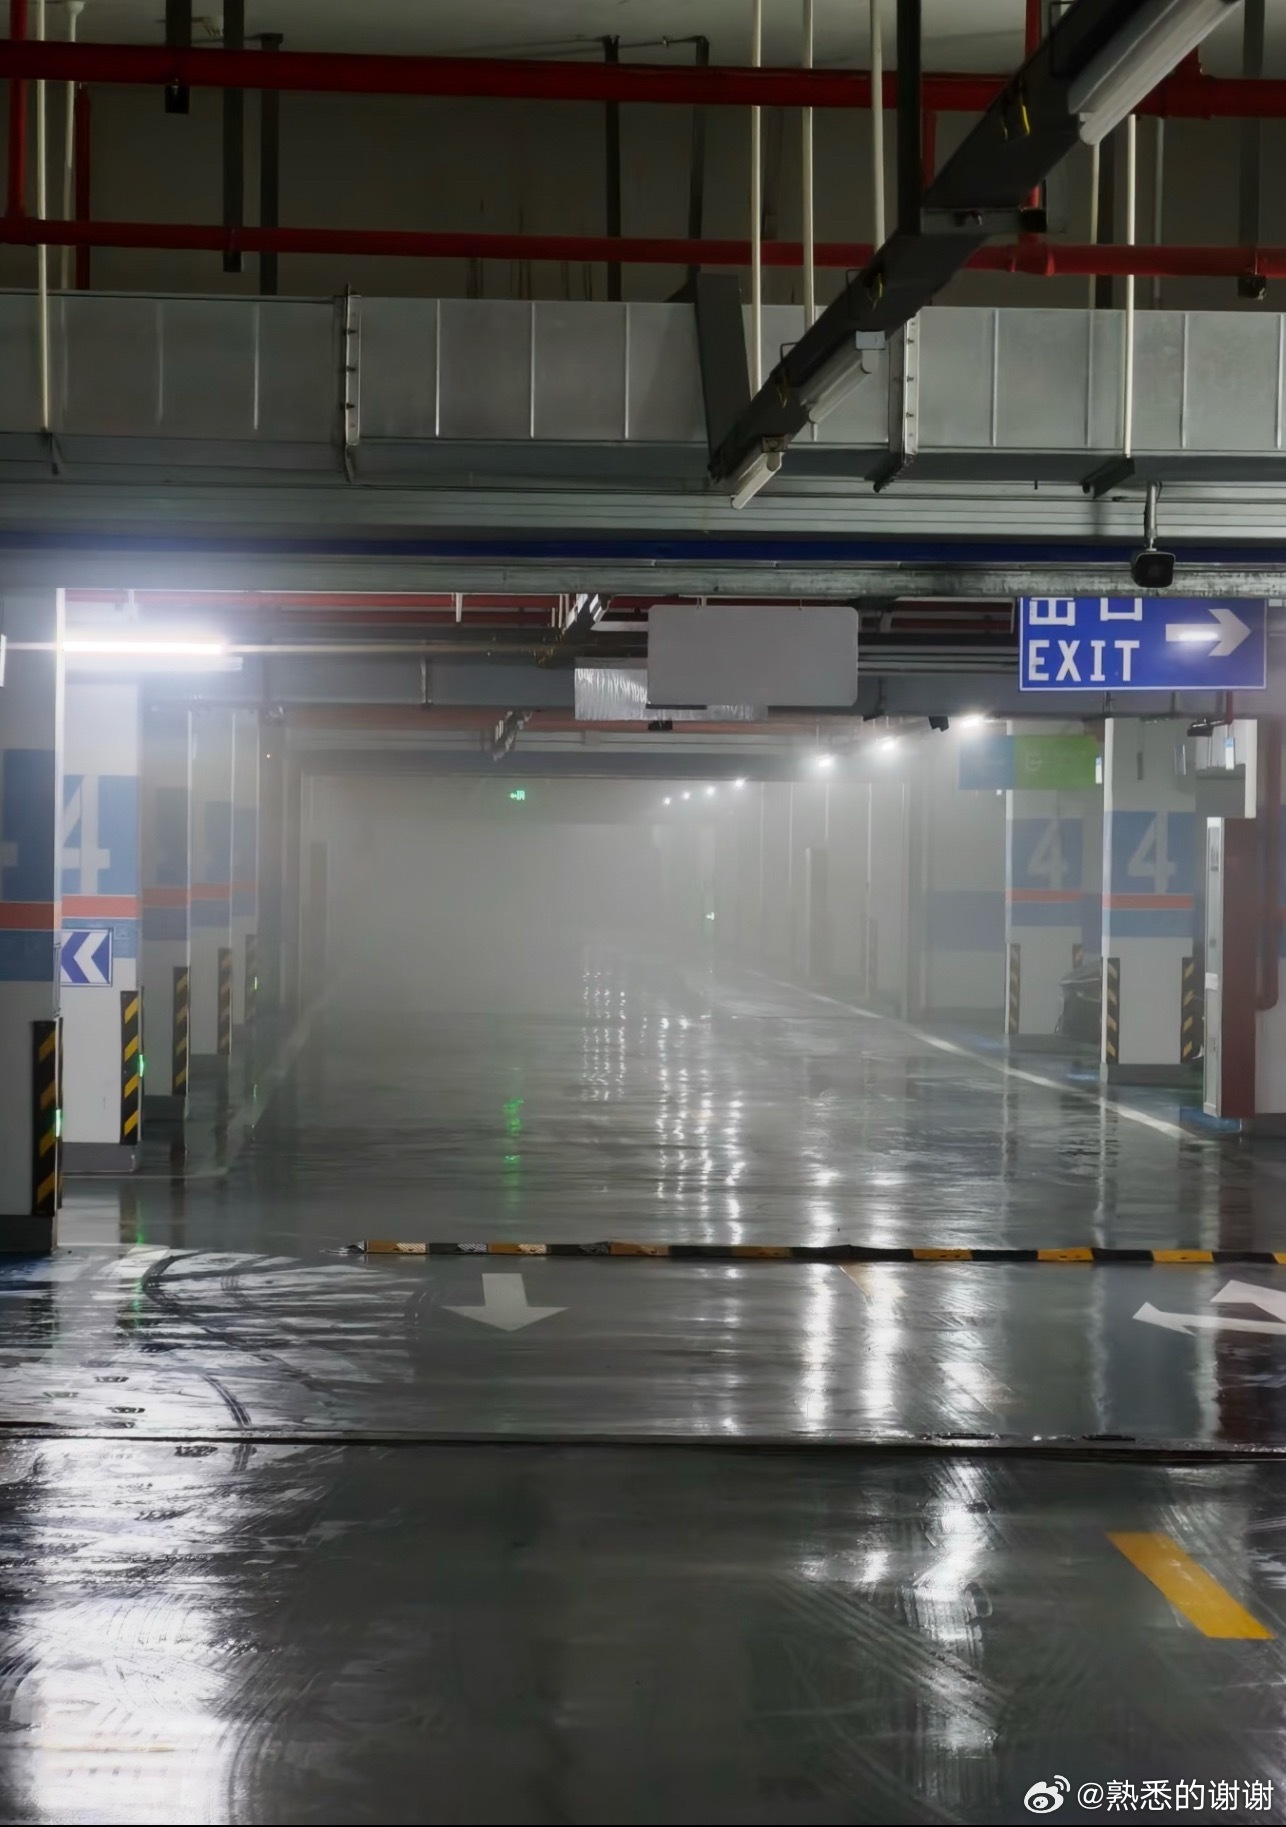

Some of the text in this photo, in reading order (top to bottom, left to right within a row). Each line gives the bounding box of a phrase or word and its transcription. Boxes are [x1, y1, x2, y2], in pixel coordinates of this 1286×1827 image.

[1028, 639, 1140, 682] EXIT
[62, 775, 111, 894] 4
[1027, 819, 1068, 889] 4
[1127, 811, 1178, 894] 4
